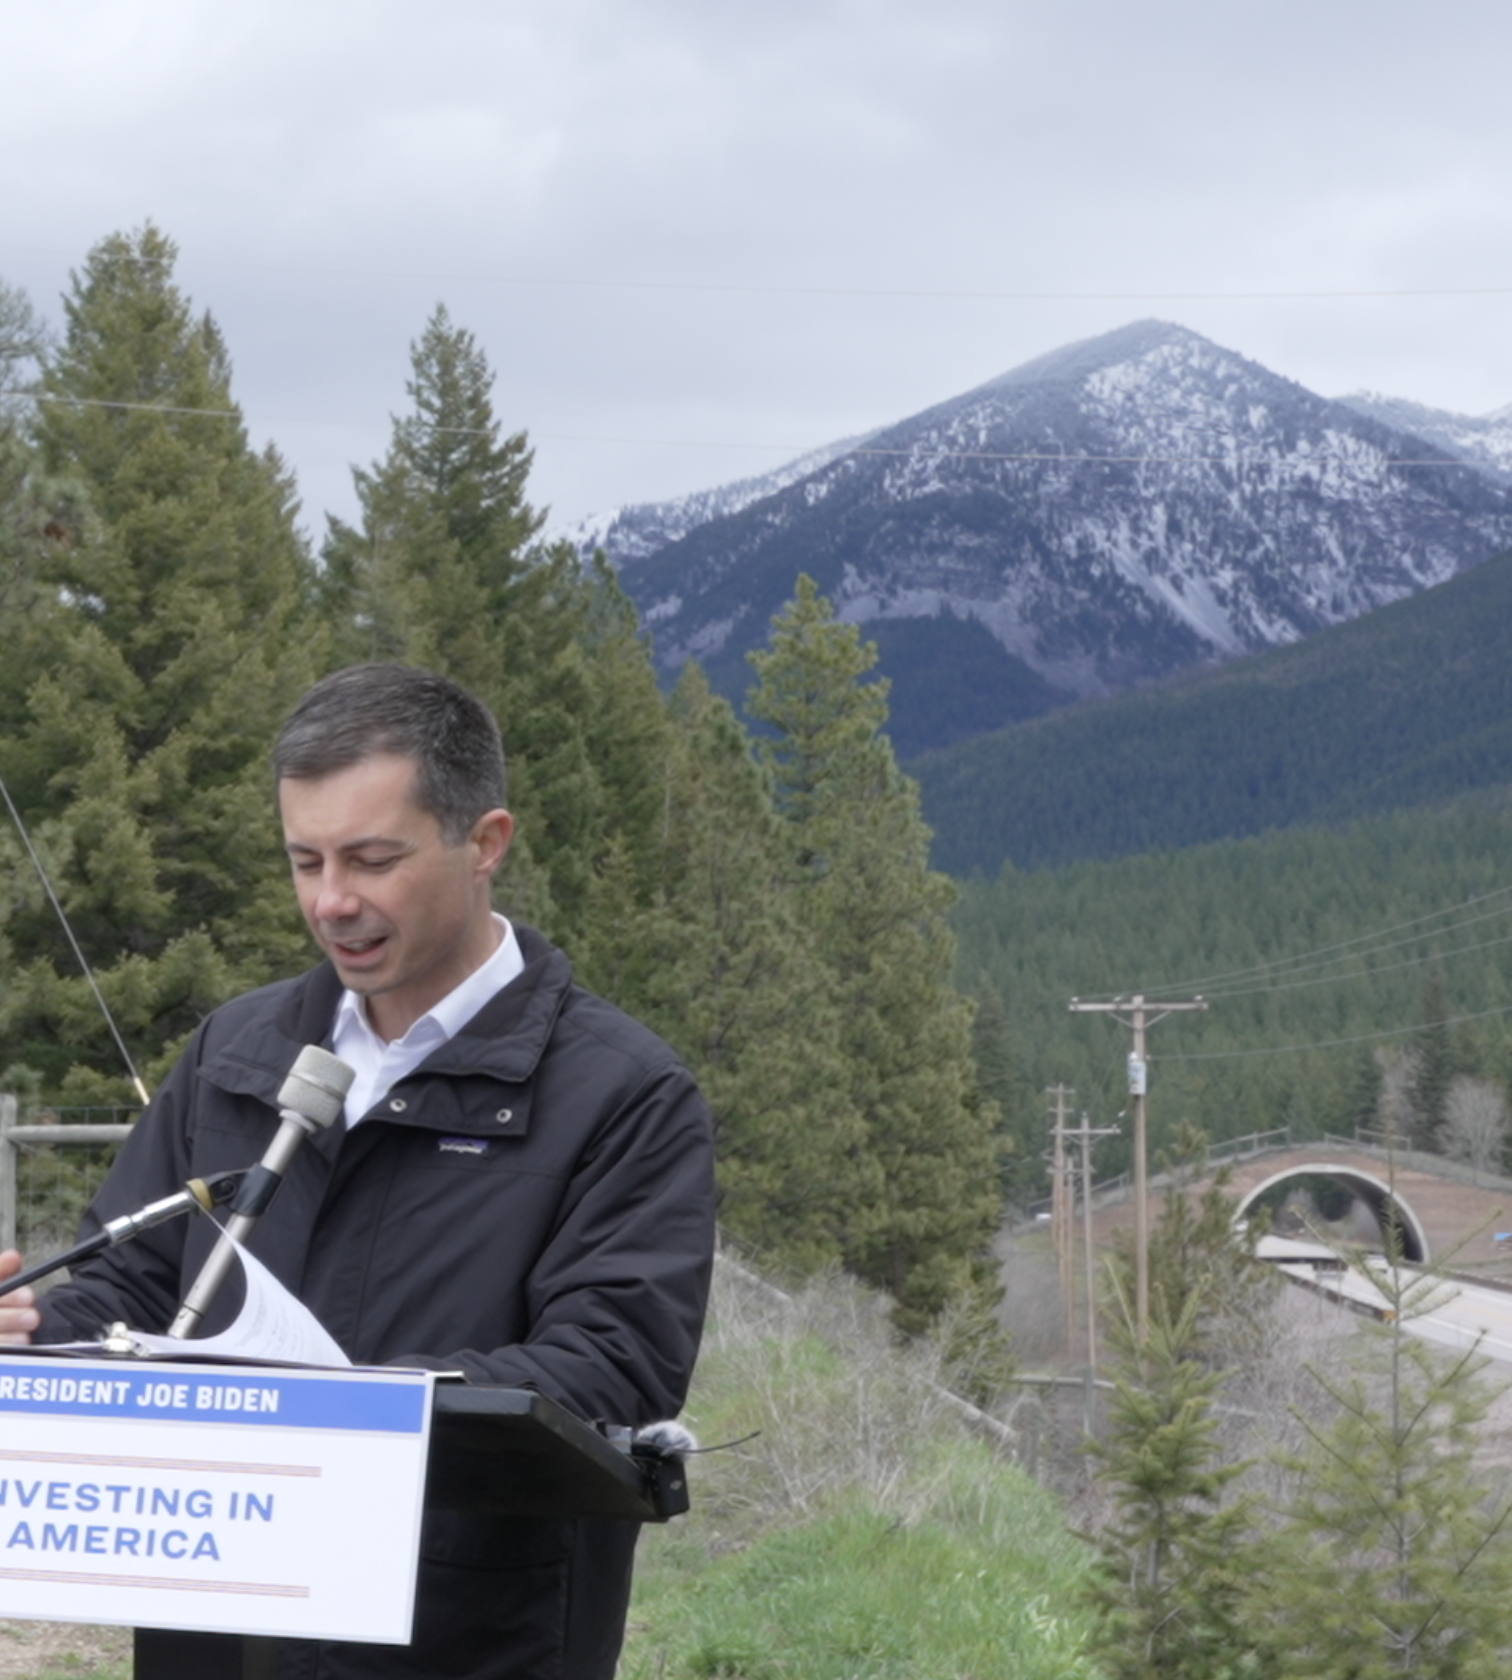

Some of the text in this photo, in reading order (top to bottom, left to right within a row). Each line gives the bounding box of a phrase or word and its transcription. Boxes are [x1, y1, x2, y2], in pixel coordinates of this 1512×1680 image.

[136, 1382, 189, 1409] JOE
[195, 1385, 280, 1413] BIDEN
[228, 1491, 275, 1522] IN
[6, 1520, 221, 1562] AMERICA
